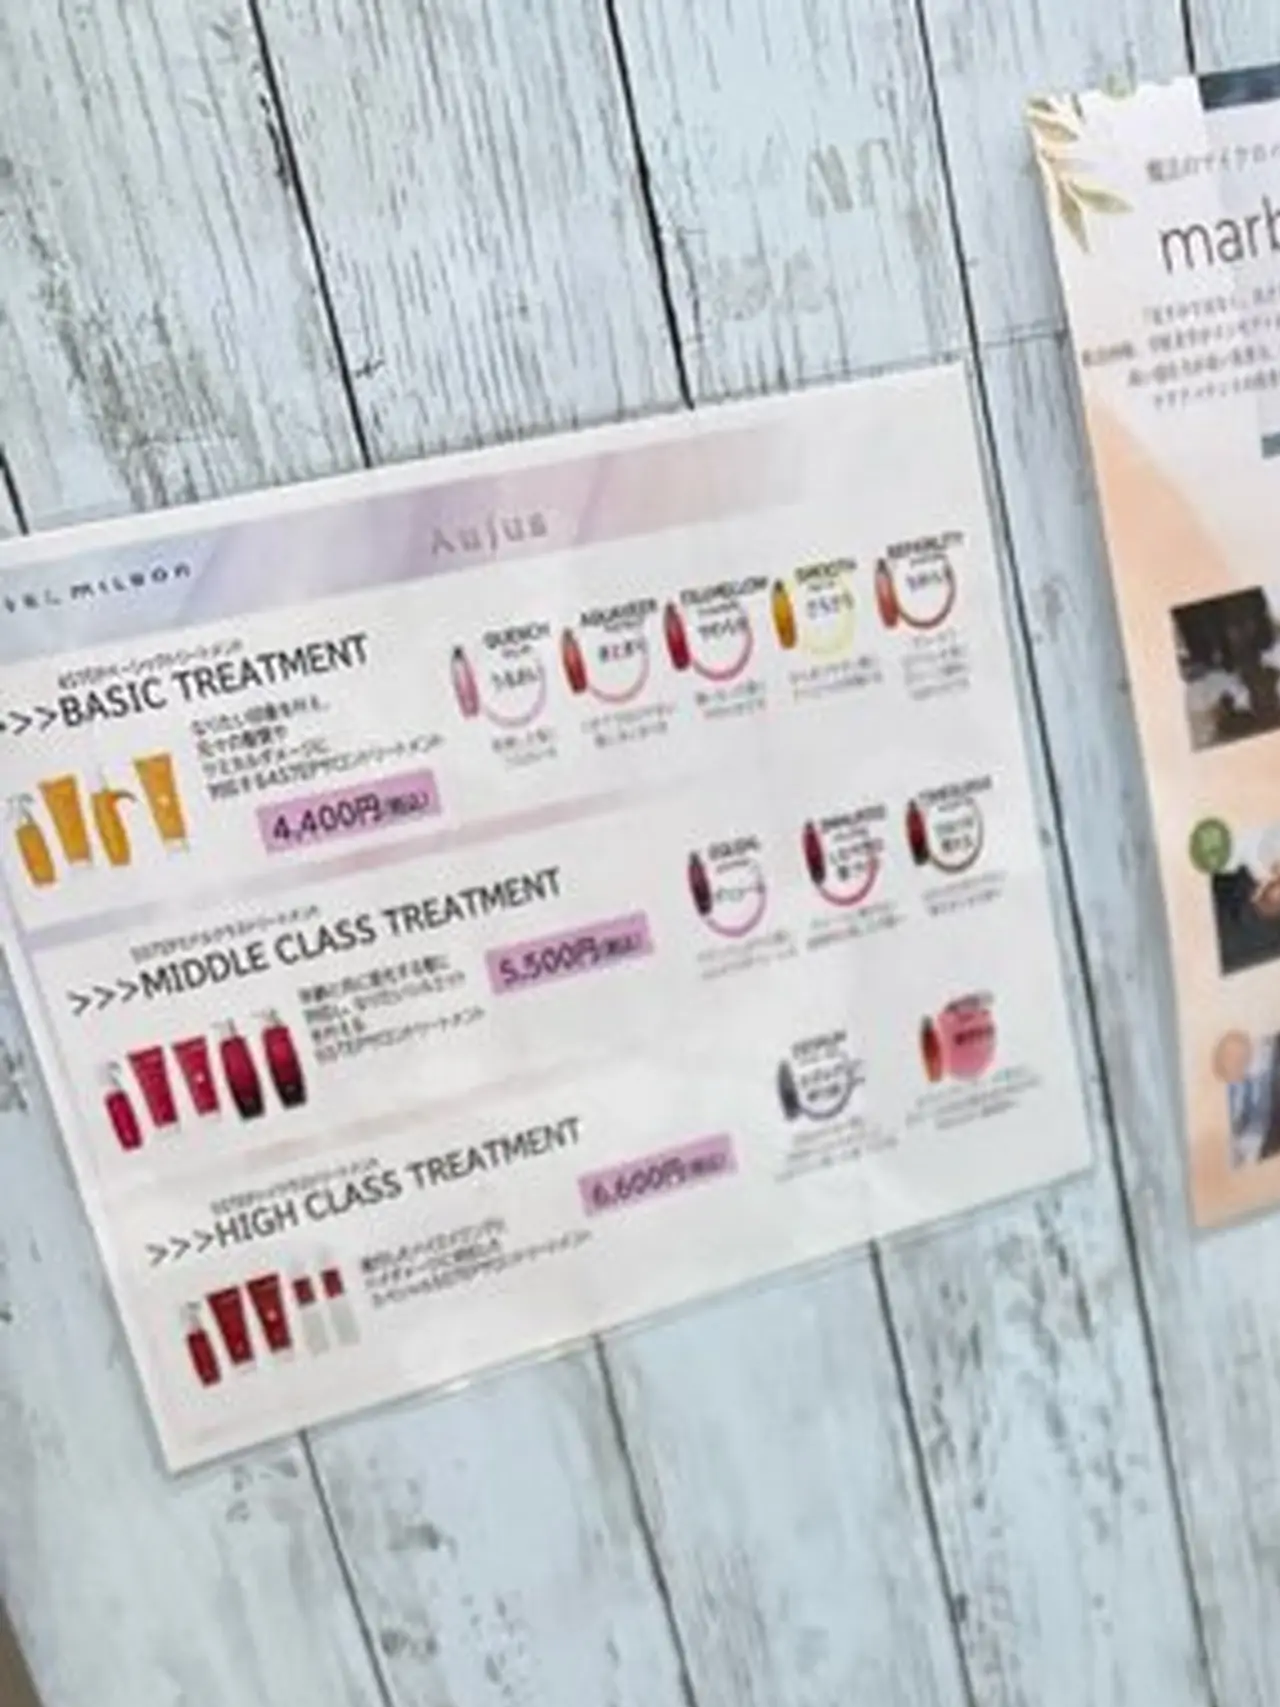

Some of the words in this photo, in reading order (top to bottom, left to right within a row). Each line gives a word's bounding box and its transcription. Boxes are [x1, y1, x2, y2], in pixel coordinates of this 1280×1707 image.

[58, 678, 169, 728] BASIC
[172, 631, 371, 702] TREATMENT
[139, 949, 269, 1000] MIDDLE
[279, 913, 378, 965] CLASS
[383, 867, 563, 937] TREATMENT
[214, 1200, 299, 1249] HIGH
[305, 1170, 404, 1222] CLASS
[406, 1116, 583, 1190] TREATMENT
